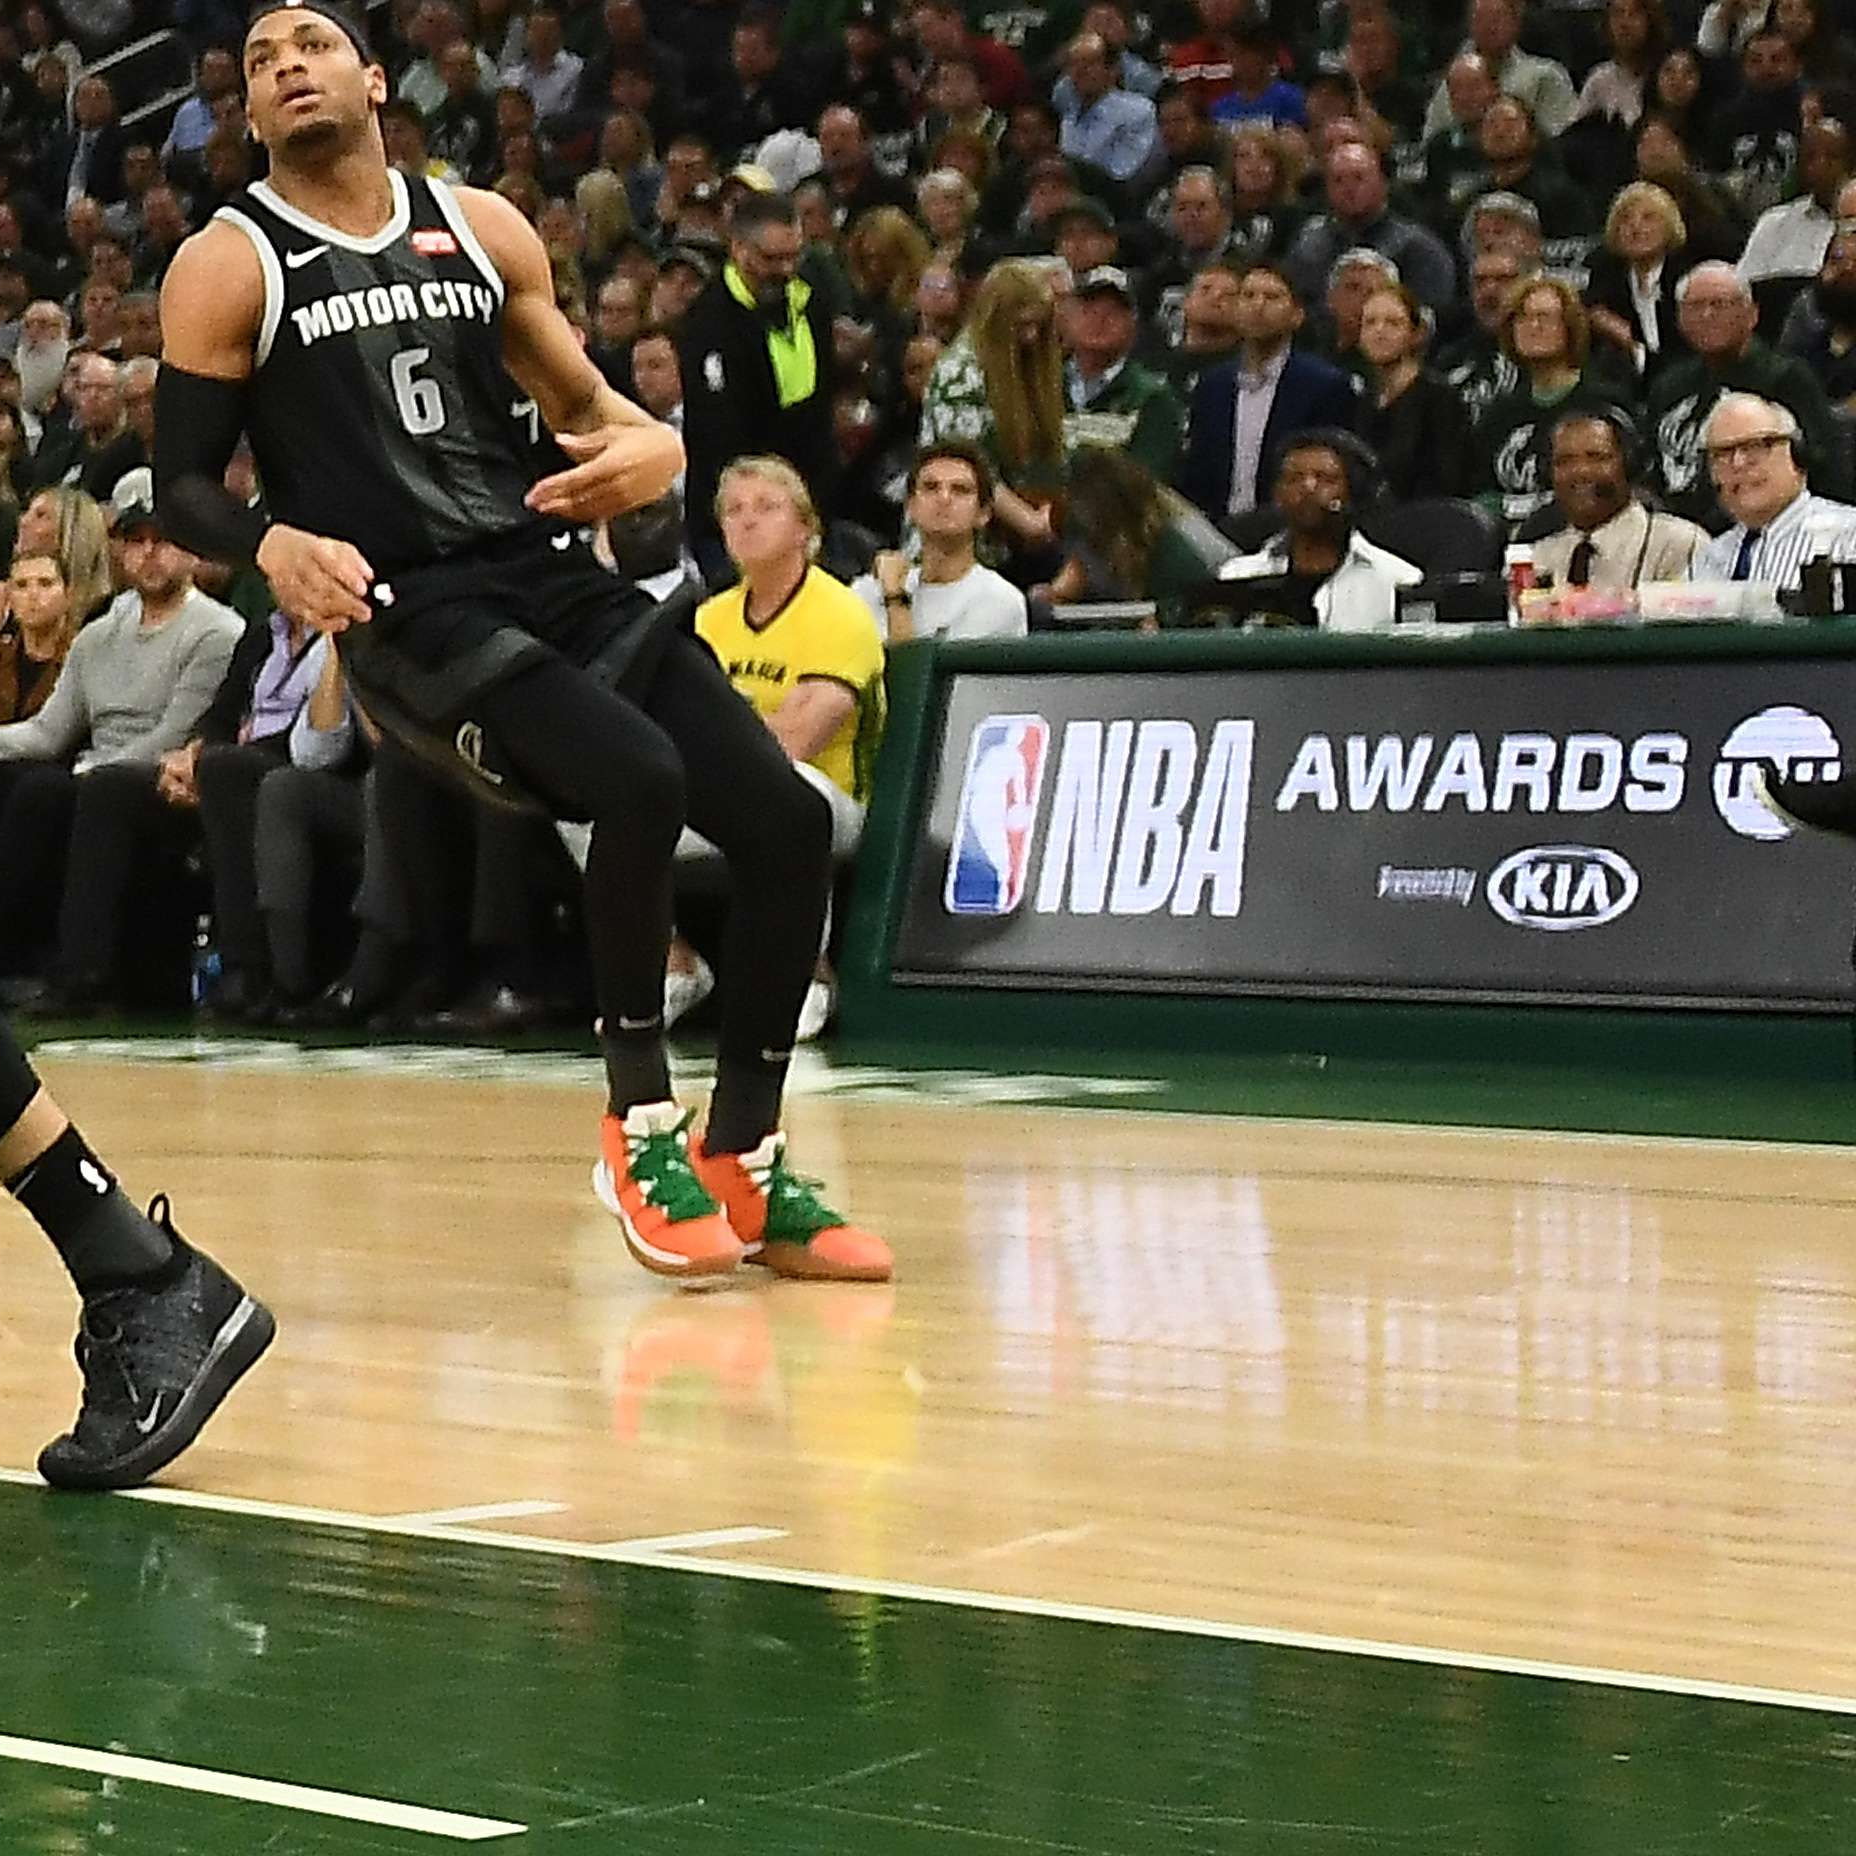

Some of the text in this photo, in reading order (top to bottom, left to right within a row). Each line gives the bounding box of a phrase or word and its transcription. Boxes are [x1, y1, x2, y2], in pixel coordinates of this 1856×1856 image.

[291, 281, 494, 347] MOTOR CITY
[389, 347, 447, 436] 6
[1033, 718, 1688, 917] NBA AWARDS
[1512, 862, 1611, 913] KIA
